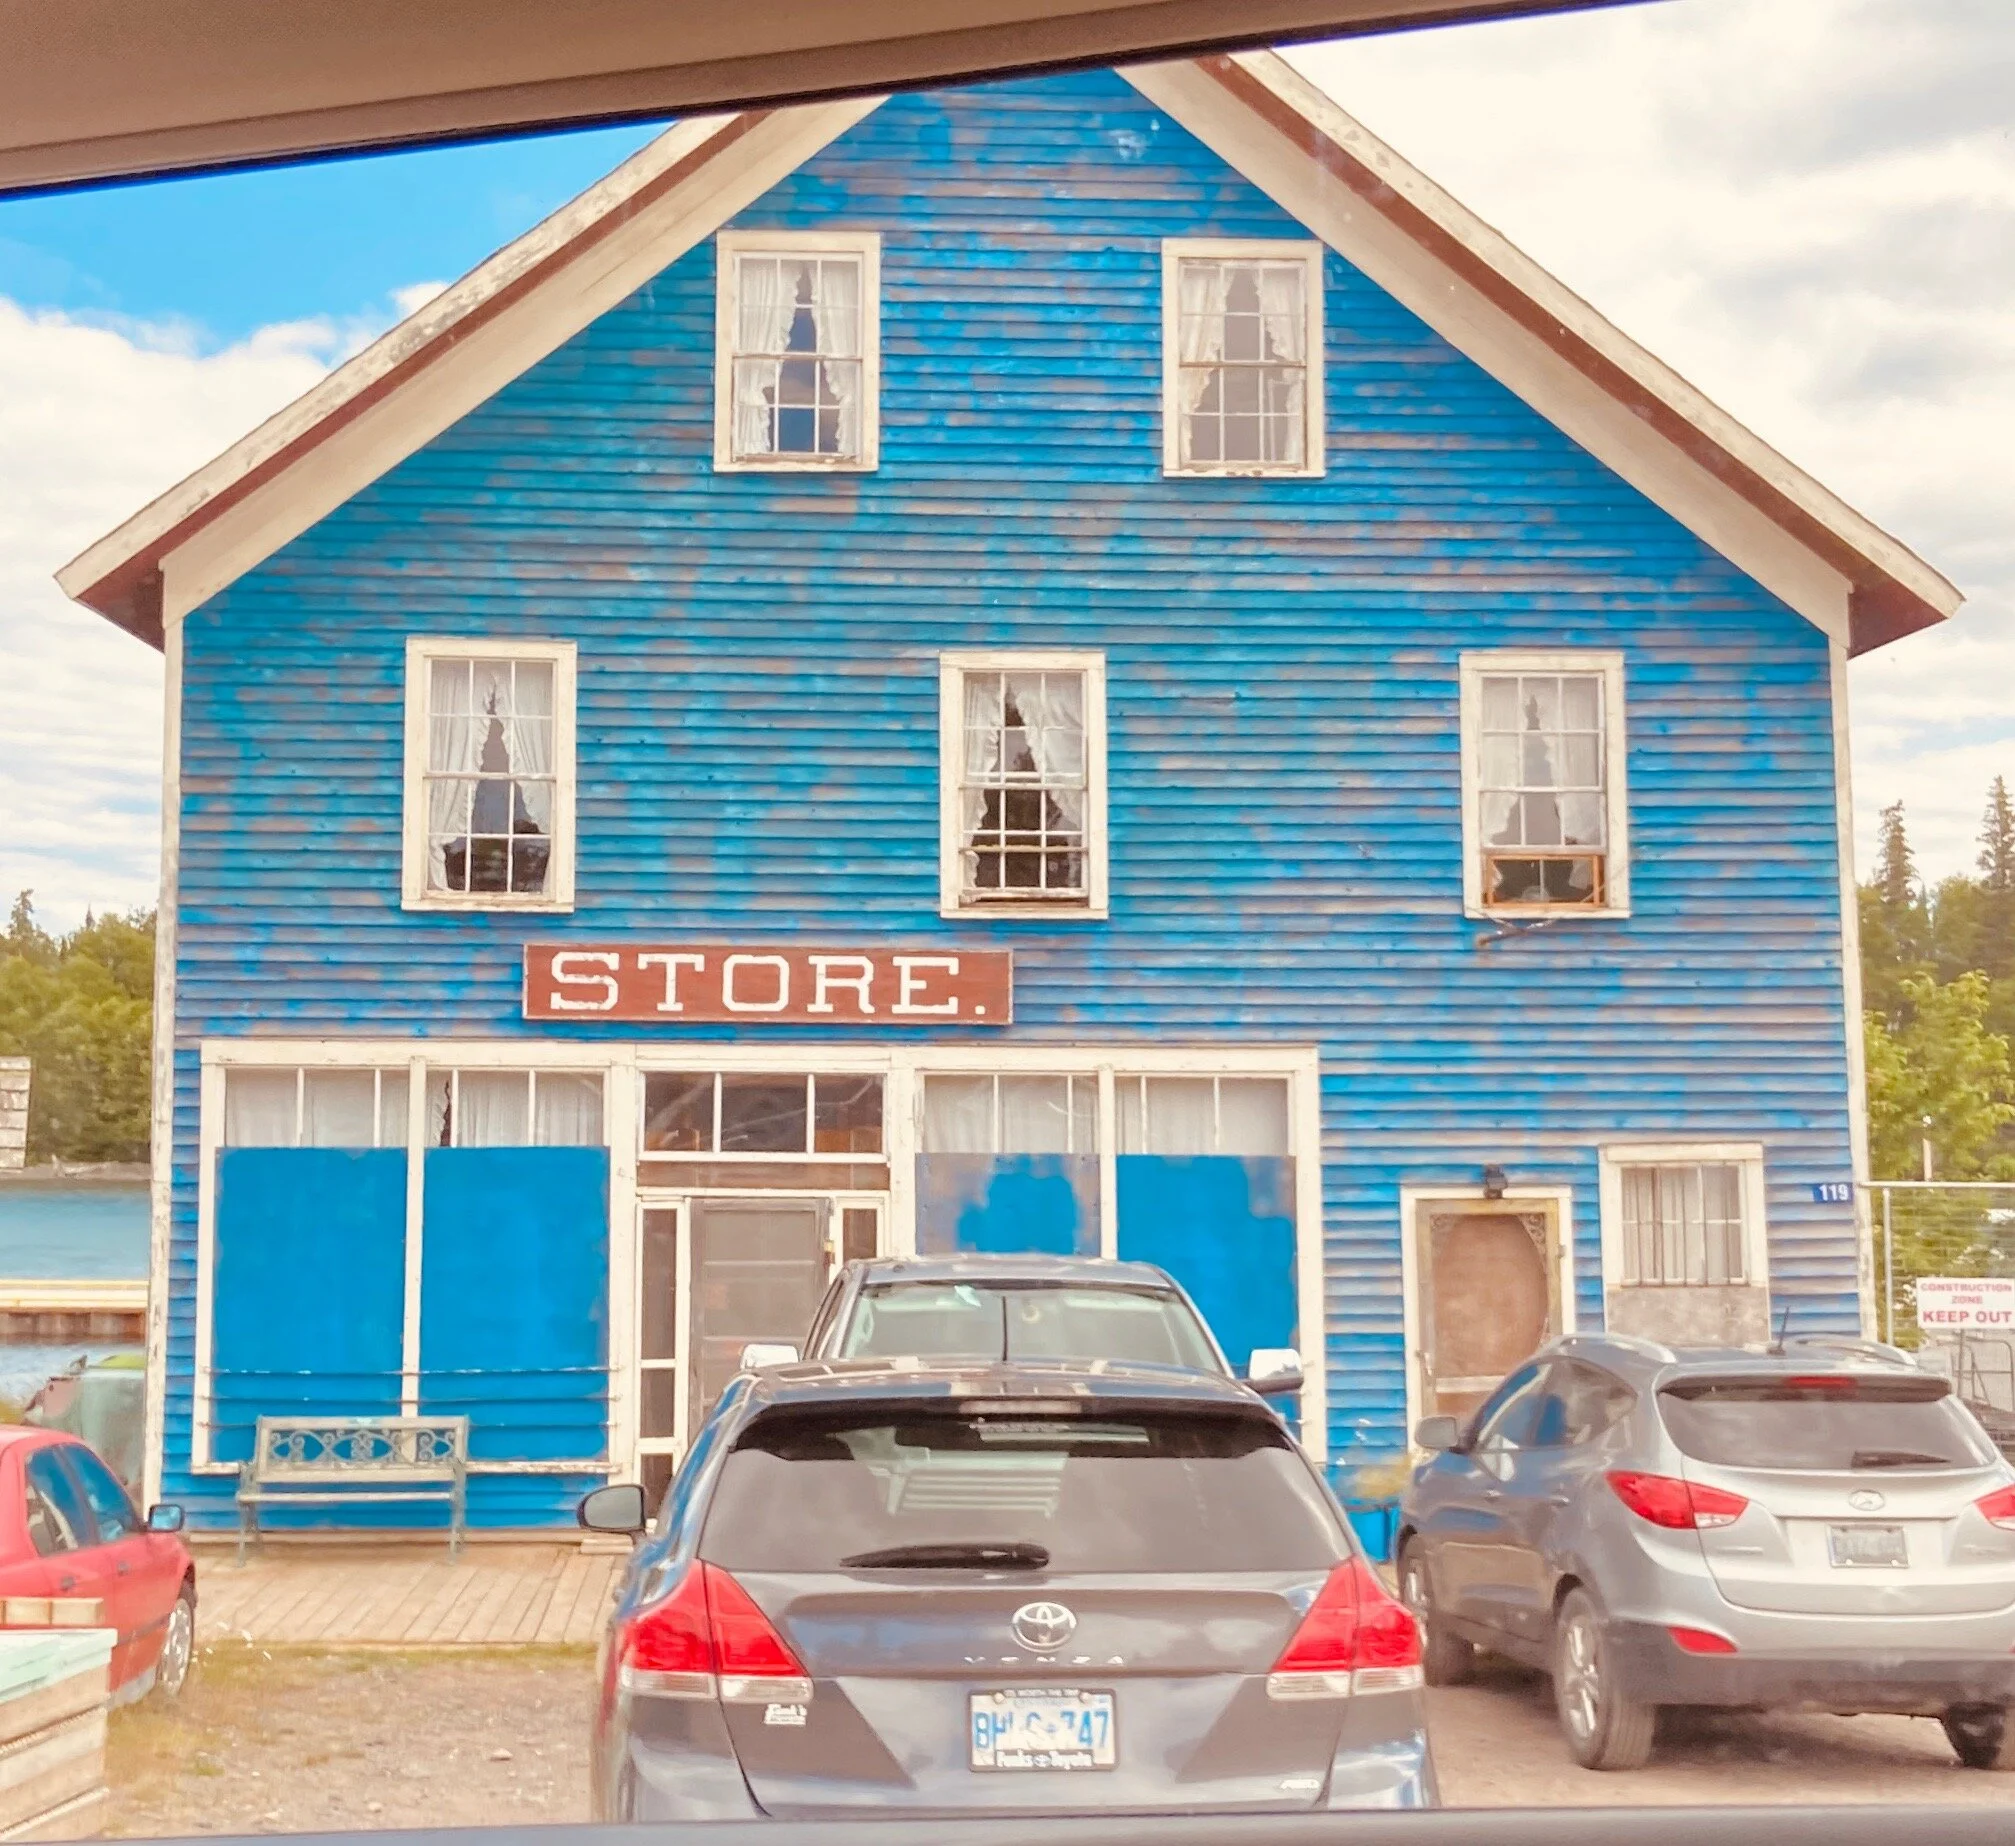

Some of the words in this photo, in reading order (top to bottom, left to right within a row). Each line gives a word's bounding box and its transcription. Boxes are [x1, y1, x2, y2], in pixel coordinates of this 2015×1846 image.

[550, 951, 986, 1014] STORE.
[1819, 1184, 1849, 1201] 119
[1920, 1283, 2012, 1292] CONSTRUCTION
[1951, 1295, 1983, 1304] ZONE
[1922, 1310, 1970, 1323] KEEP
[1975, 1310, 2013, 1323] OUT
